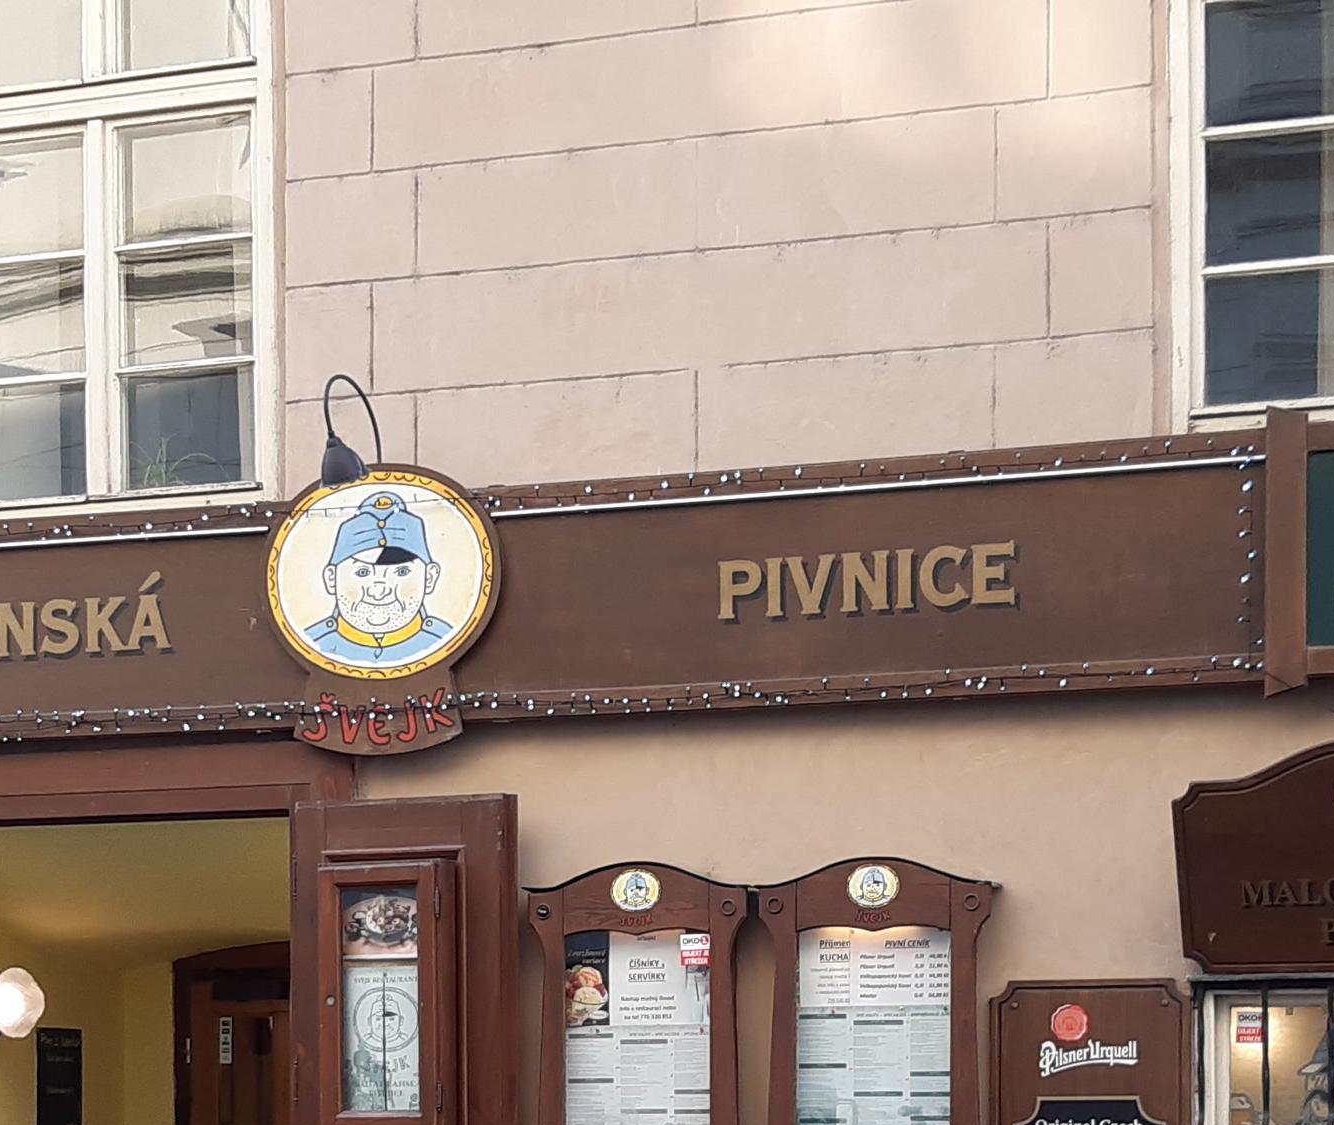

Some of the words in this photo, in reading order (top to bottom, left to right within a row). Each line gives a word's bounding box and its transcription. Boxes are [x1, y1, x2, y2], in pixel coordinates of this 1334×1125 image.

[718, 540, 1016, 620] PIVNICE
[301, 687, 455, 746] ŠVEJK
[819, 953, 851, 962] KUCHA
[1039, 1040, 1090, 1077] Pilsner
[1087, 1039, 1138, 1066] Urquell
